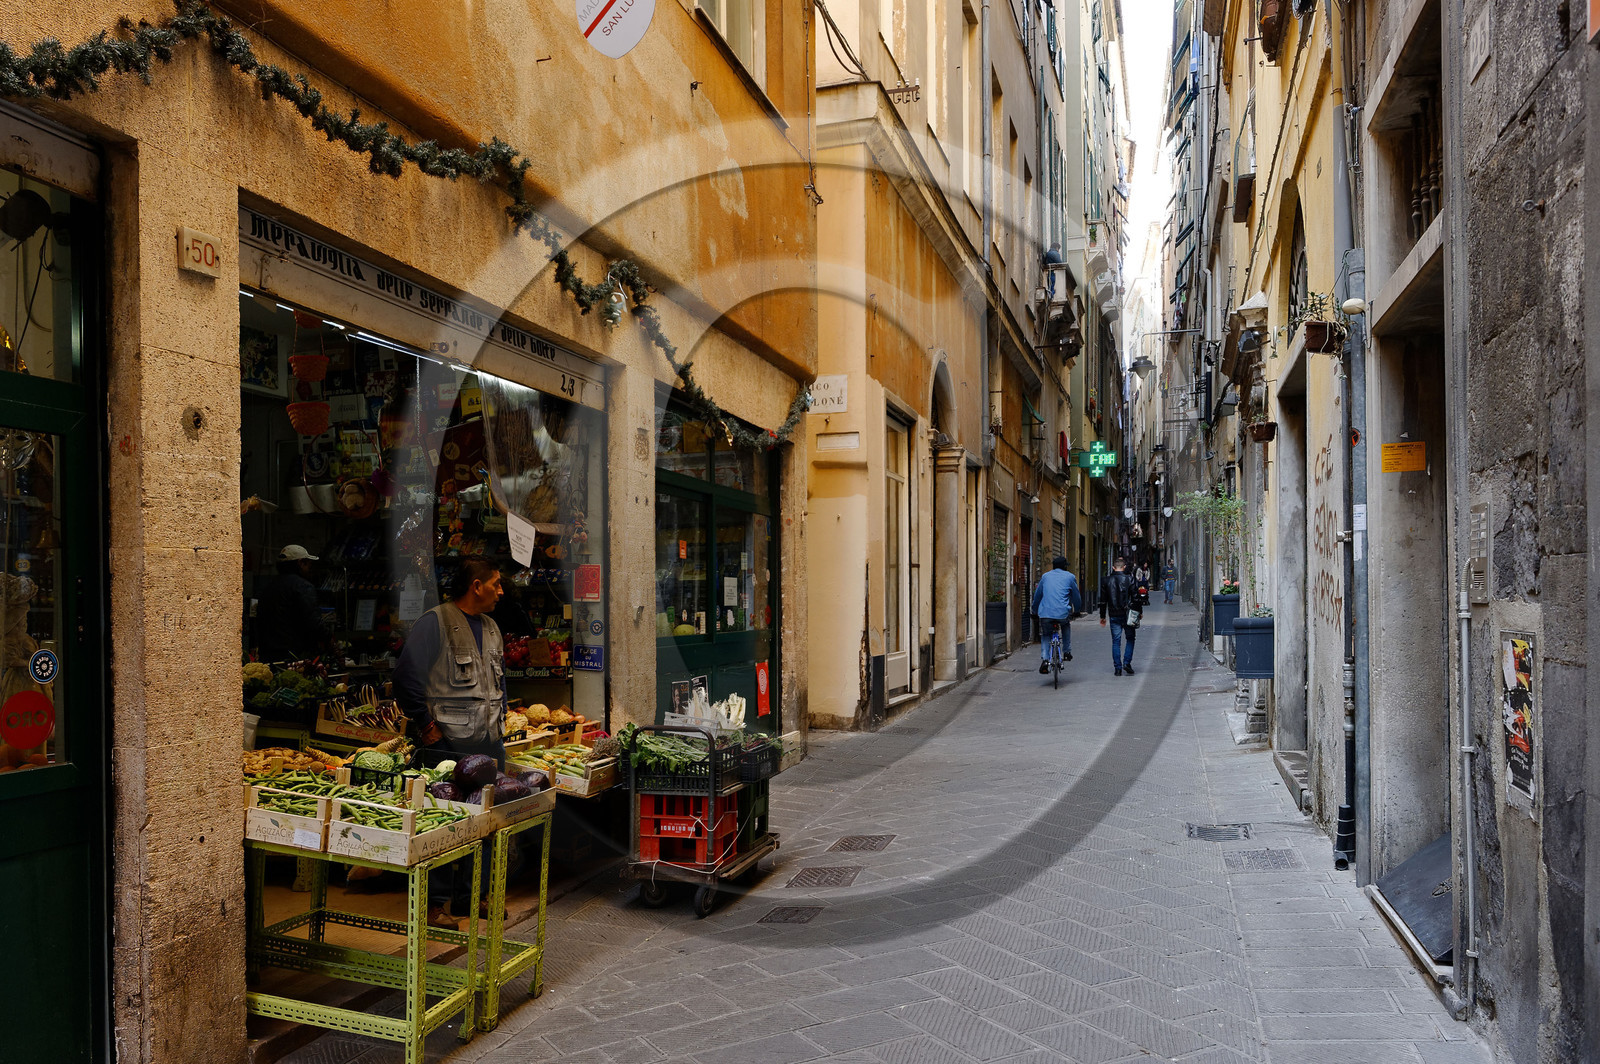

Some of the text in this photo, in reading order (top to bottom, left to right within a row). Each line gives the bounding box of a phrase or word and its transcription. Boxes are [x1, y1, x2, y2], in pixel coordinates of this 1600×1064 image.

[602, 12, 623, 37] SAN
[809, 382, 830, 391] ICO
[813, 396, 844, 407] LONE
[574, 660, 602, 668] MISTRAL
